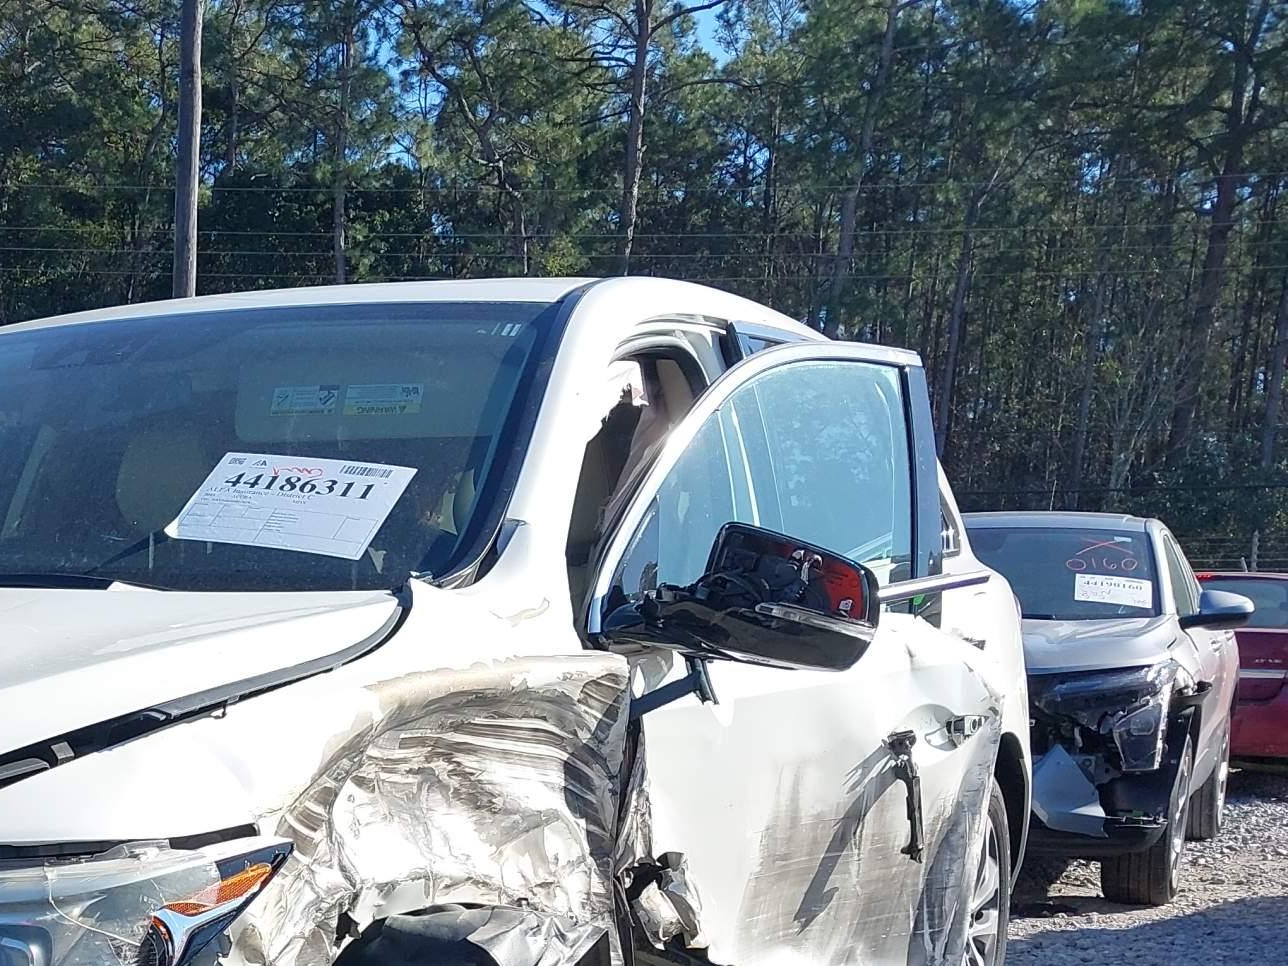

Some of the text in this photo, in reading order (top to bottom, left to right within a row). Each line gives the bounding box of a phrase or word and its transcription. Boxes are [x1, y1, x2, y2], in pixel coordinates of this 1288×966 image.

[224, 471, 375, 501] 44186311
[232, 488, 270, 497] Insurance
[276, 491, 306, 500] District
[1065, 557, 1138, 571] 0160
